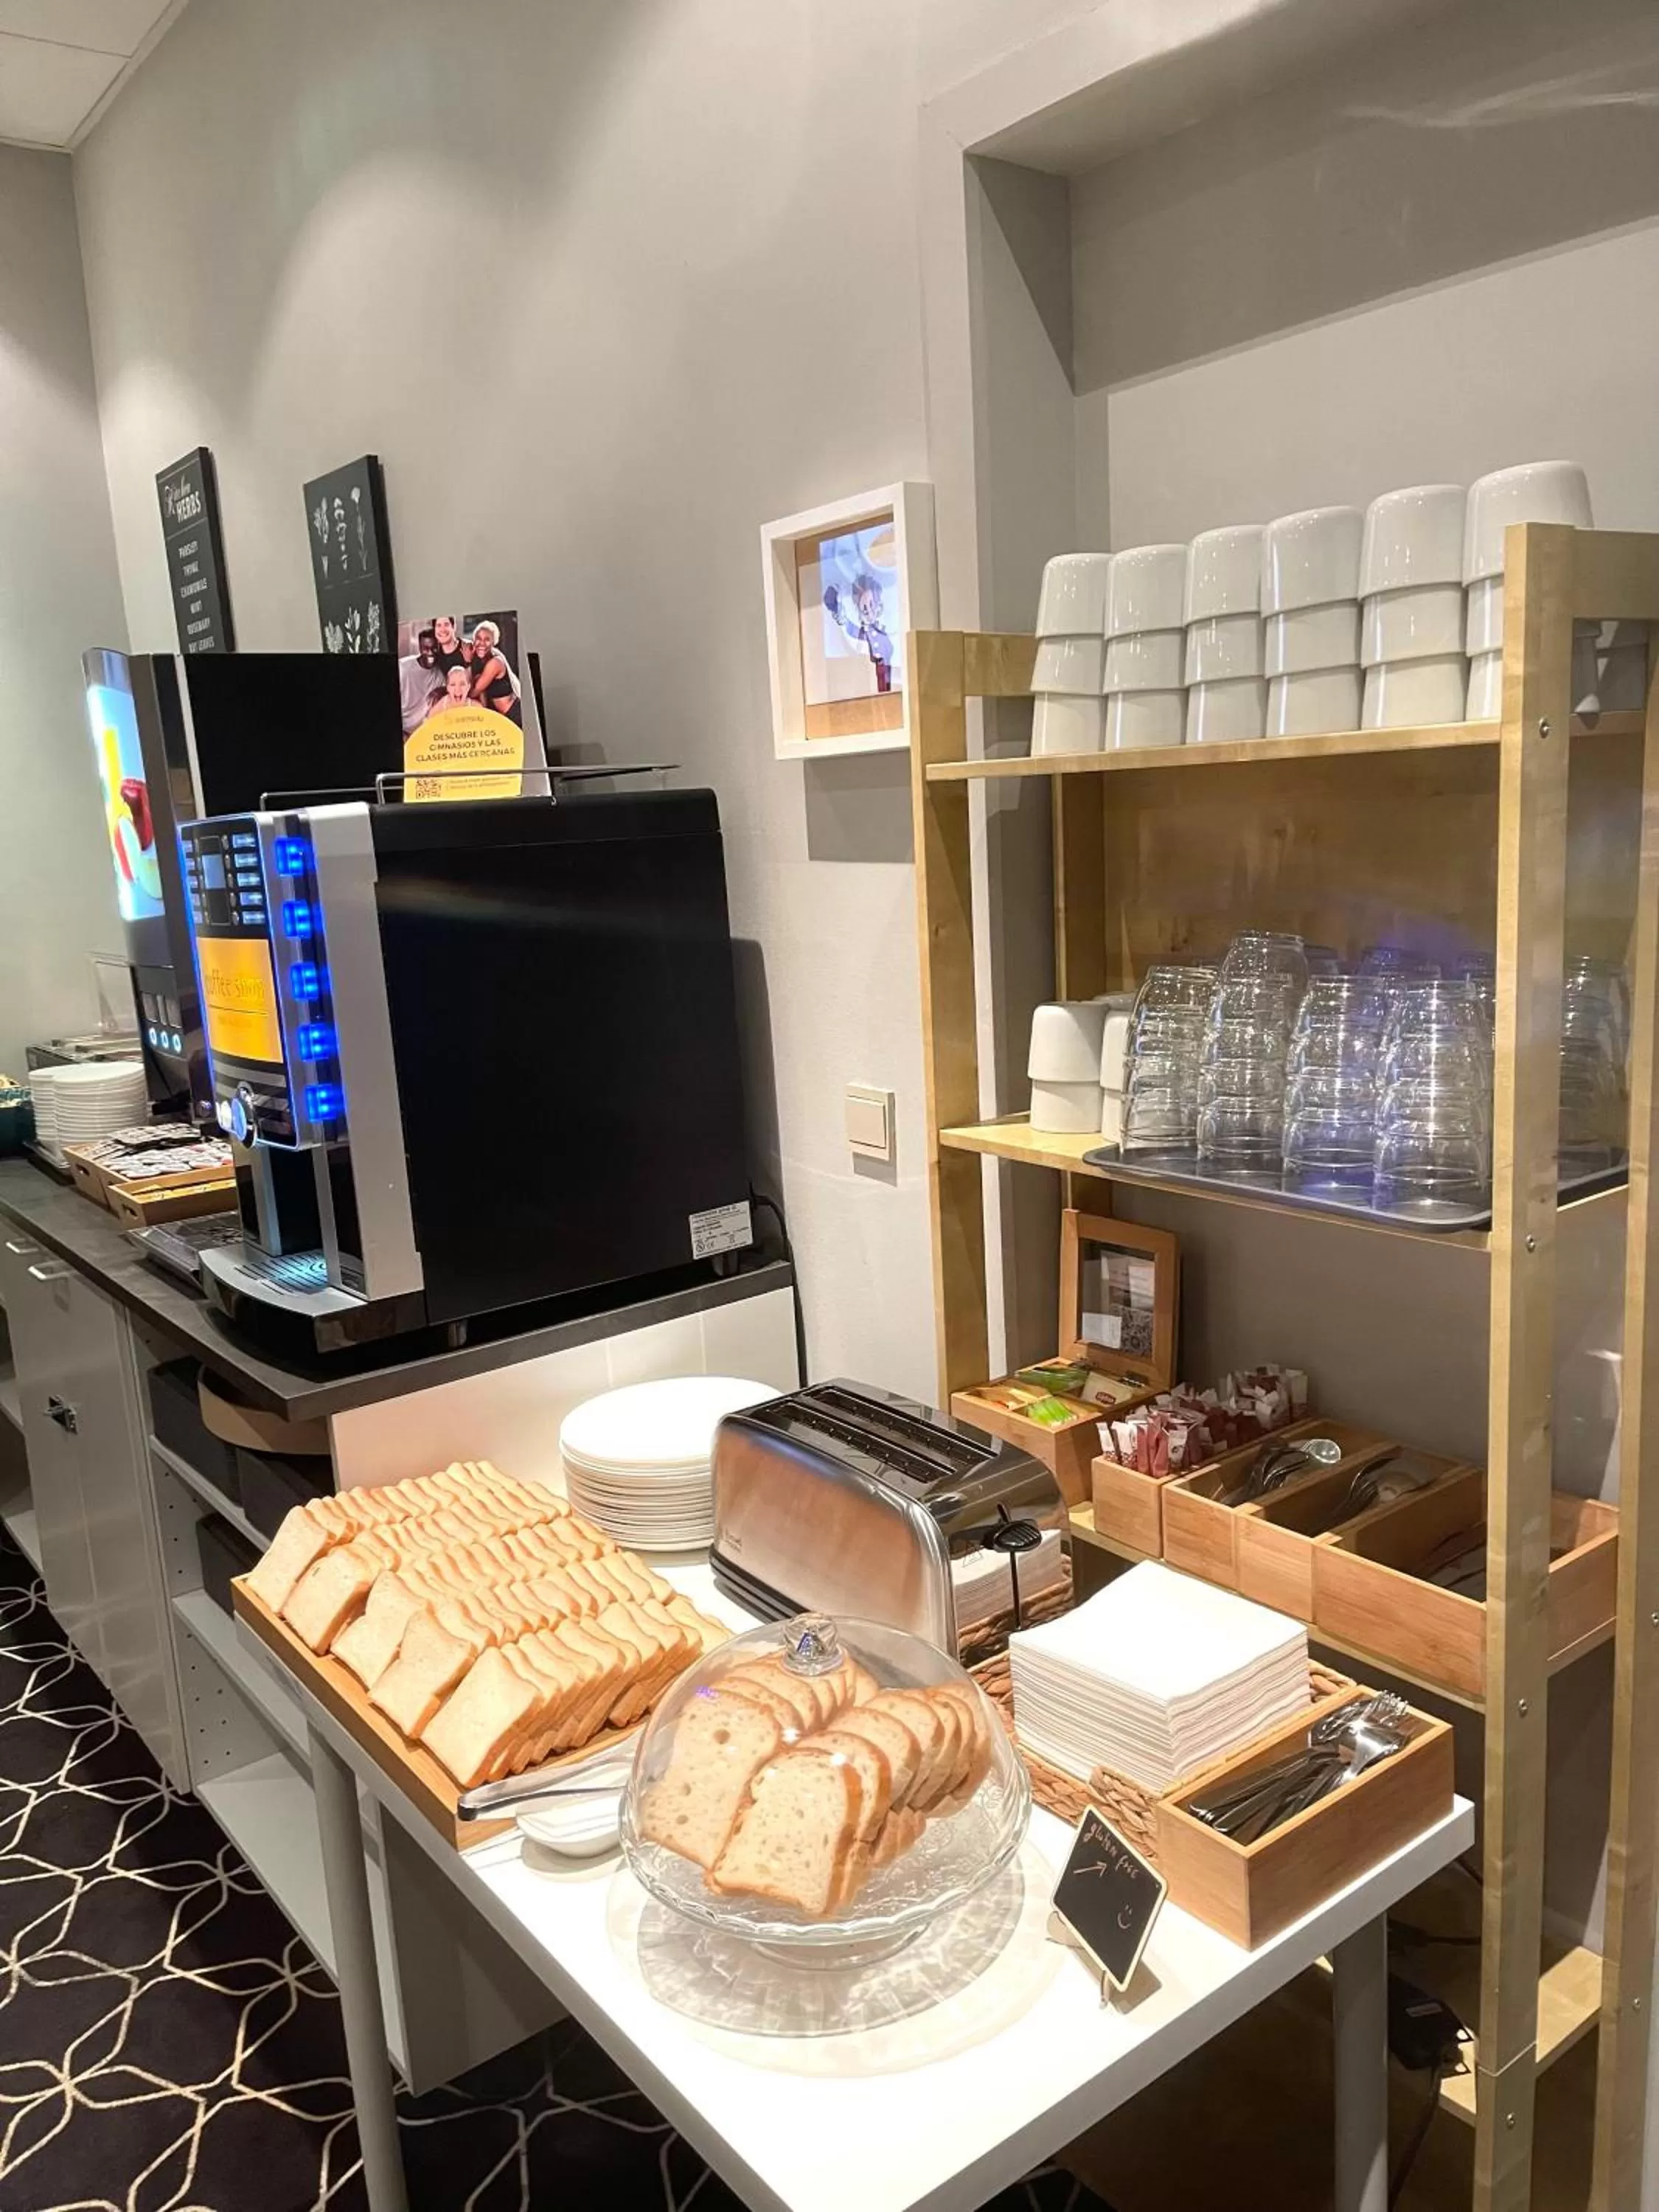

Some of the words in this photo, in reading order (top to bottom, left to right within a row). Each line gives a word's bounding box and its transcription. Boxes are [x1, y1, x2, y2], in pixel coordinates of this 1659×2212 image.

[176, 490, 201, 523] HERBS
[434, 731, 478, 740] DESCUBRE
[480, 729, 496, 738] LOS
[429, 741, 476, 751] GIMNASIOS
[484, 738, 501, 747] LAS
[415, 752, 448, 762] CLASES
[469, 748, 515, 757] CERCANAS
[1115, 1855, 1139, 1879] free
